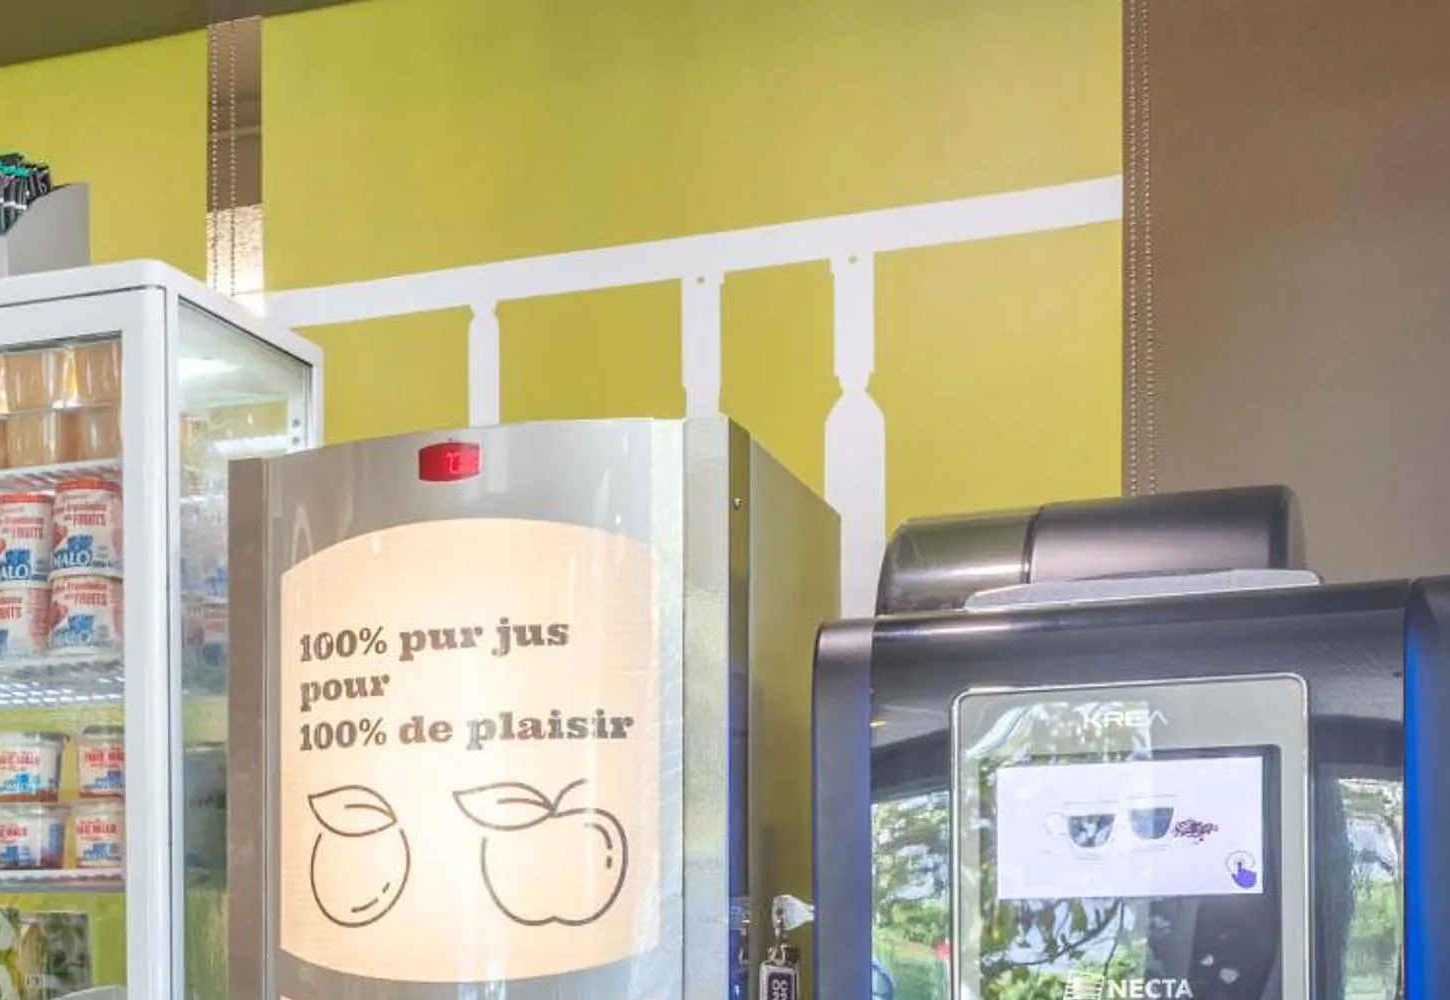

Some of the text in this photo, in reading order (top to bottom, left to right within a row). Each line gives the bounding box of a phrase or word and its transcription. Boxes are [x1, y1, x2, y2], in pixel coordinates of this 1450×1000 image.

[300, 617, 570, 662] 100% pur jus
[300, 674, 391, 712] pour
[300, 709, 635, 751] 100% de plaisir
[1109, 978, 1194, 1000] NECTA
